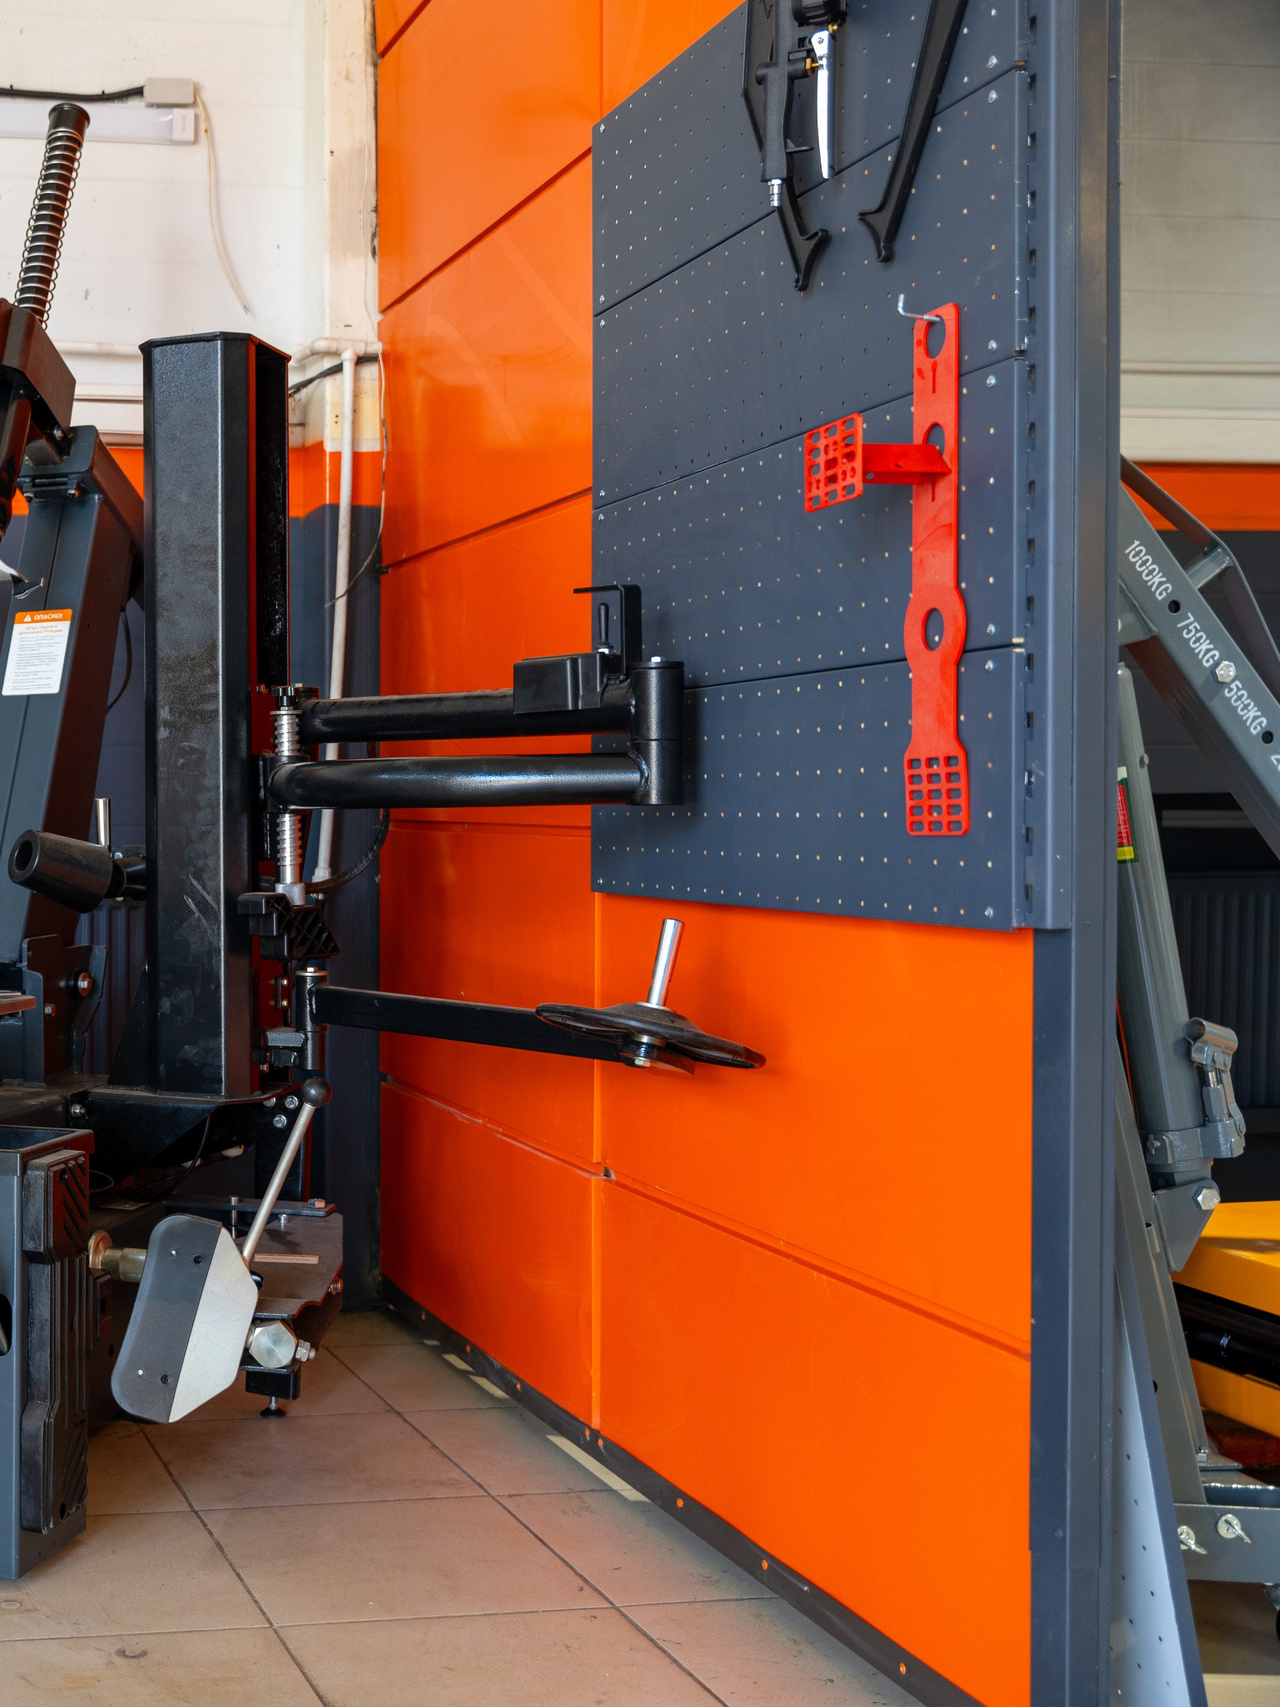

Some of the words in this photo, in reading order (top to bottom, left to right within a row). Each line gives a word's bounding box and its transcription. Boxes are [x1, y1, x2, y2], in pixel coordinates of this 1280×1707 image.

[1124, 540, 1173, 601] 1000KG
[33, 613, 63, 621] ОПАСНО!
[1177, 612, 1220, 668] 750KG
[1224, 680, 1267, 735] 500KG
